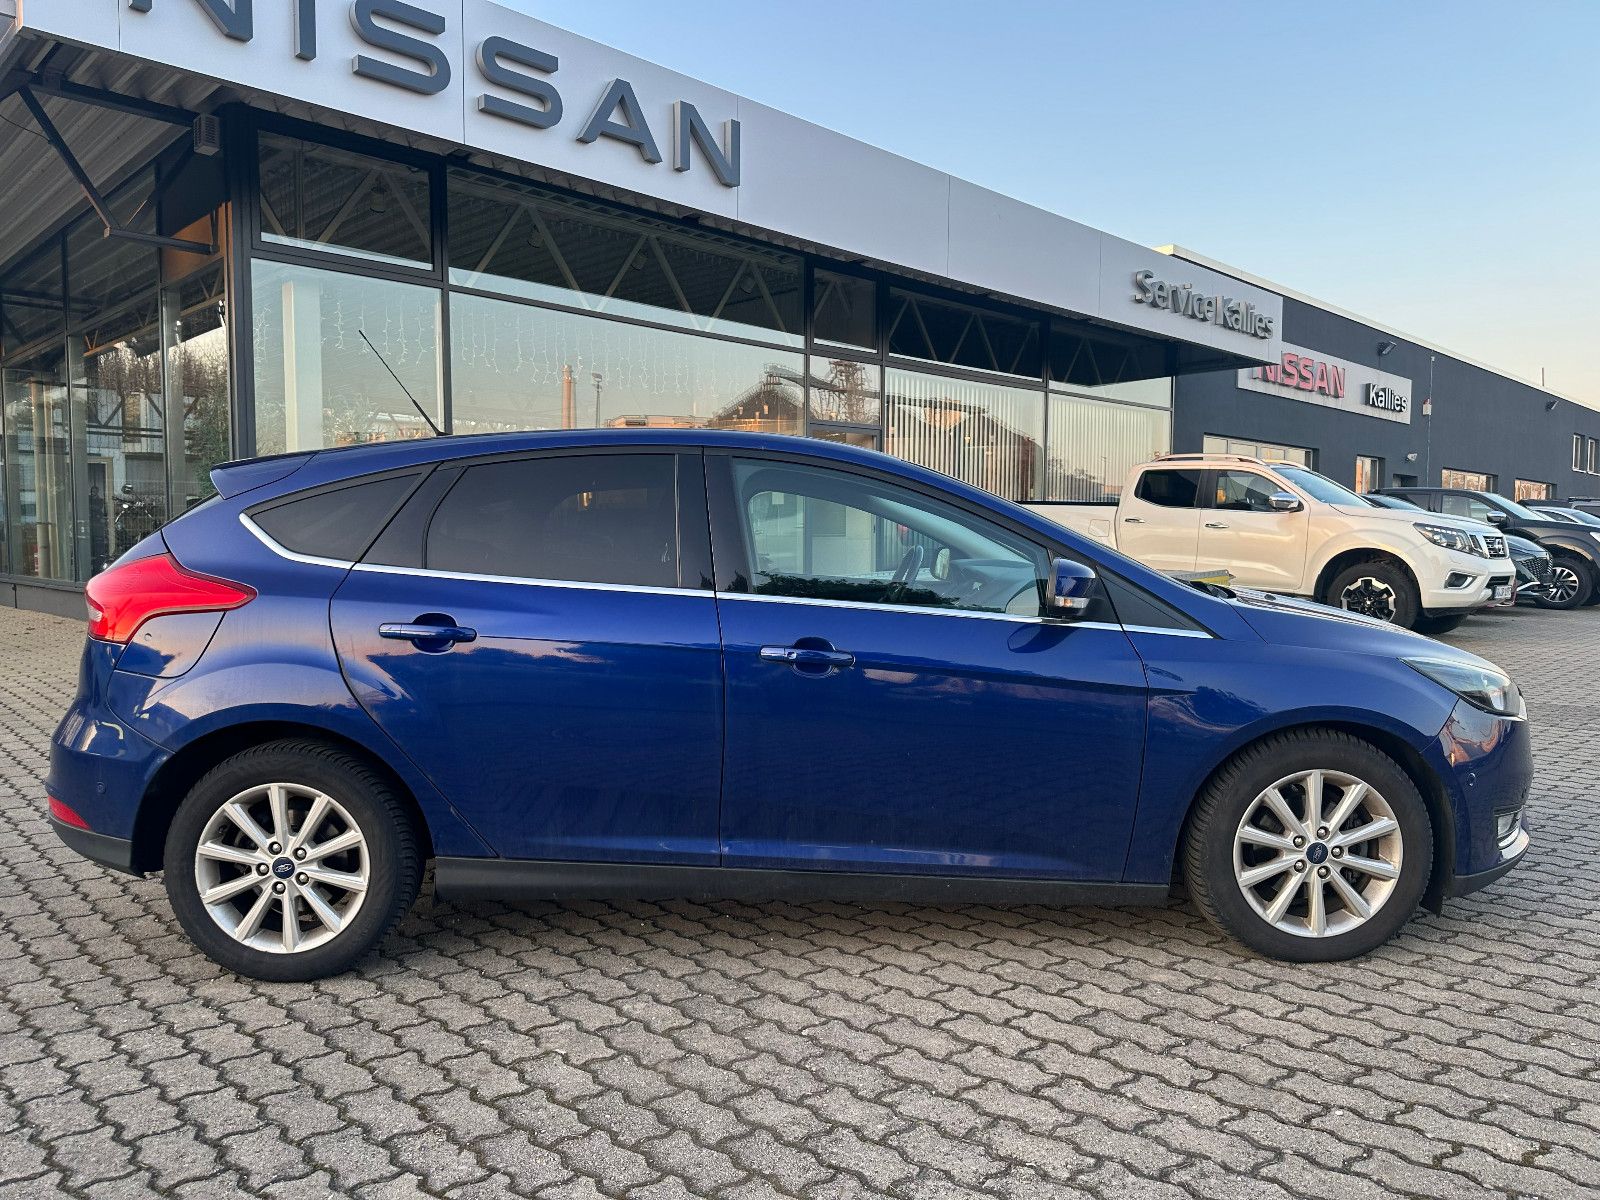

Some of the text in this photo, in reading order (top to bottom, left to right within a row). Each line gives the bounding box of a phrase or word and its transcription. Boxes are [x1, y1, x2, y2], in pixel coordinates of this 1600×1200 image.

[129, 0, 740, 187] ISSAN
[1135, 270, 1274, 339] Service Kallies
[1367, 383, 1408, 413] Kallies
